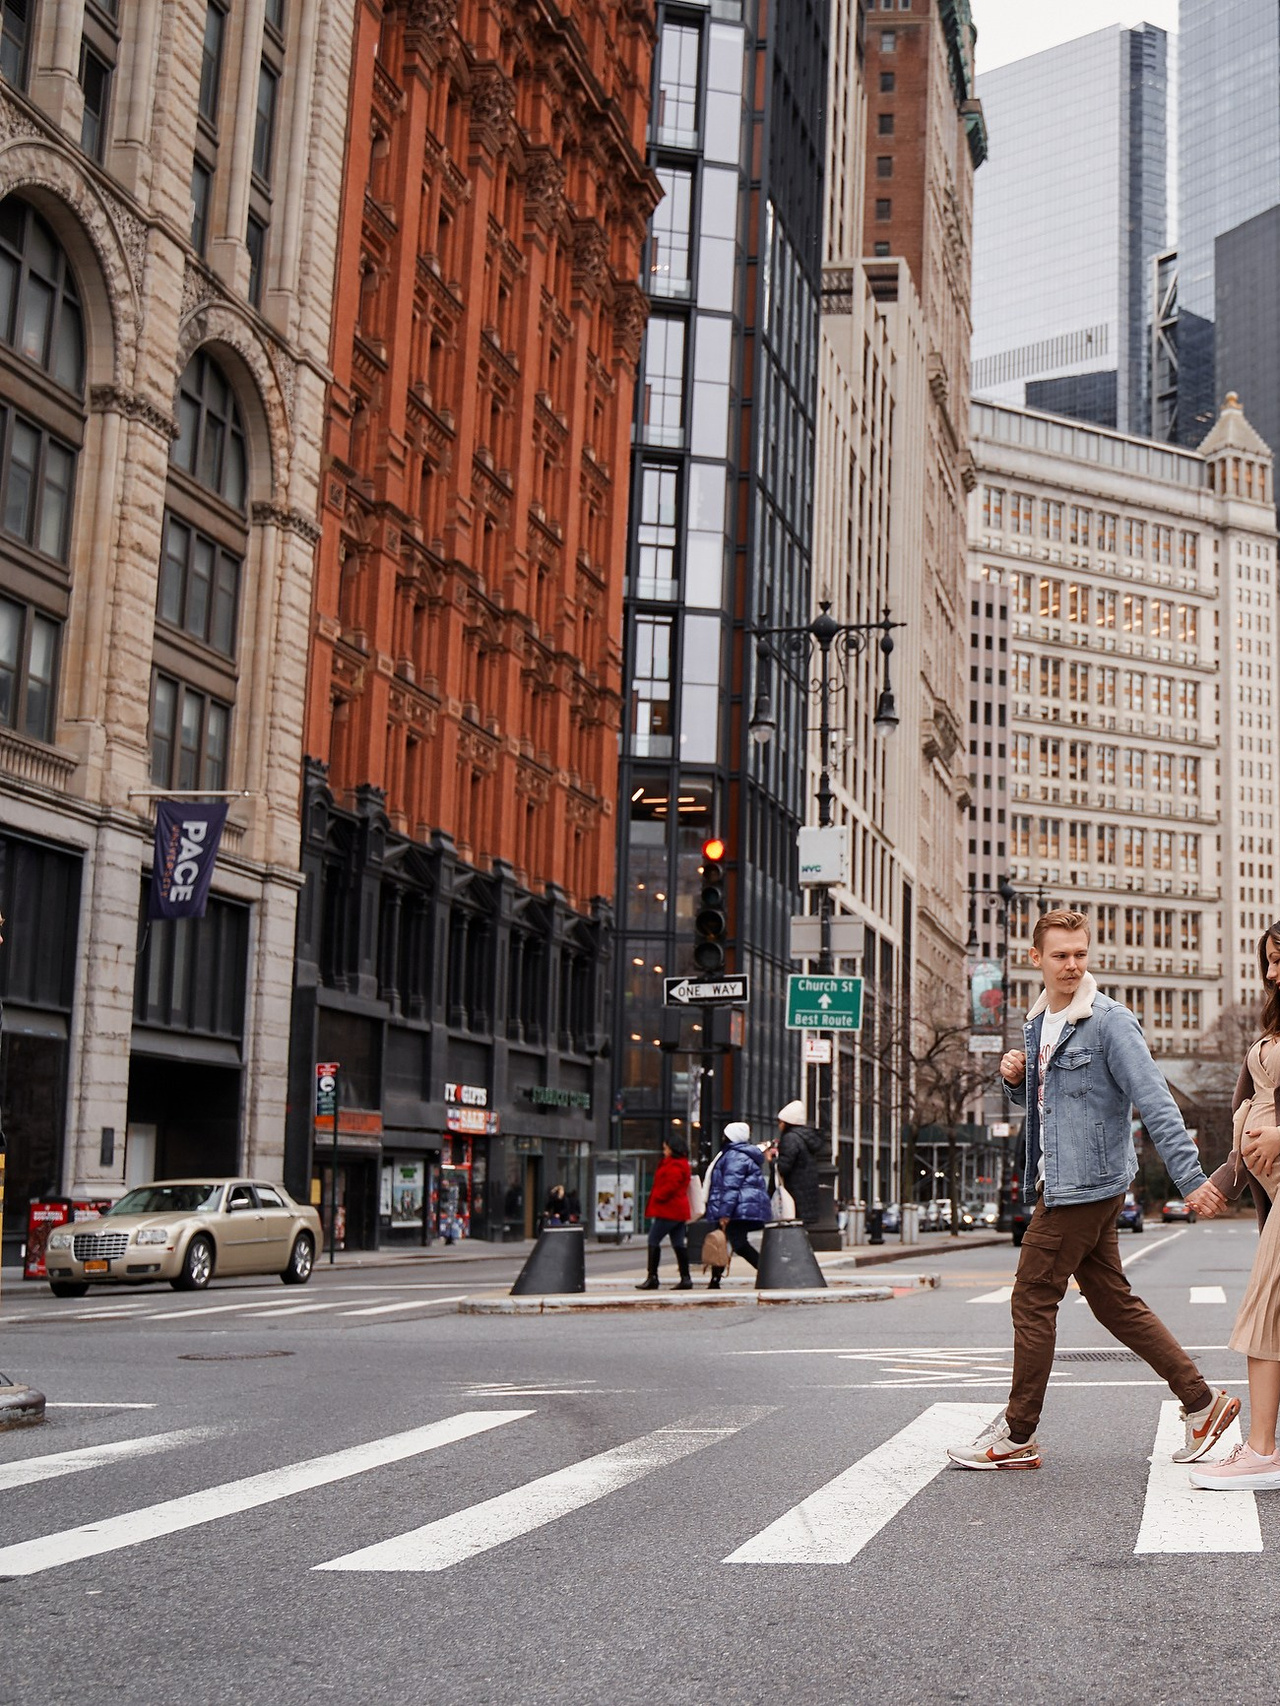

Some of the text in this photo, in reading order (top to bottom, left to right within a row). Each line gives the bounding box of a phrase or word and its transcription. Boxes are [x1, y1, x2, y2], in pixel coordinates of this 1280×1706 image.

[169, 821, 208, 902] PACE
[801, 864, 822, 873] NYC
[678, 984, 738, 998] ONE WAY
[797, 979, 854, 993] Church St
[795, 1013, 853, 1027] Best Route
[459, 1109, 485, 1130] SALE
